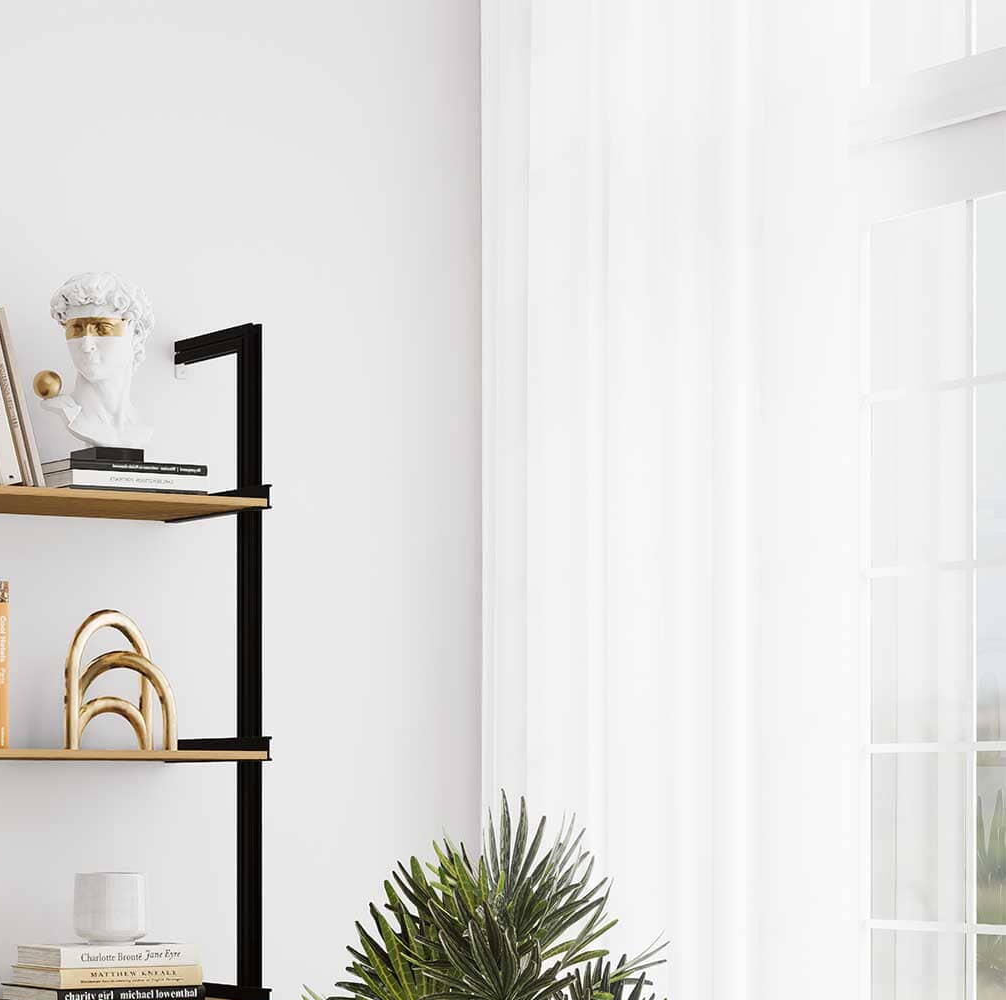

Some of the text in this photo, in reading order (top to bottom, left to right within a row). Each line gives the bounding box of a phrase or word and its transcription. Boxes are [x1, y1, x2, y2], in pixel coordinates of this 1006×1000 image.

[0, 616, 7, 634] Cool
[80, 953, 115, 963] Charlotte
[144, 950, 163, 961] Jane
[164, 949, 181, 960] Eyre
[90, 968, 177, 978] MATTHEW KNEALE
[120, 988, 154, 999] michael
[155, 987, 198, 998] lowenthal
